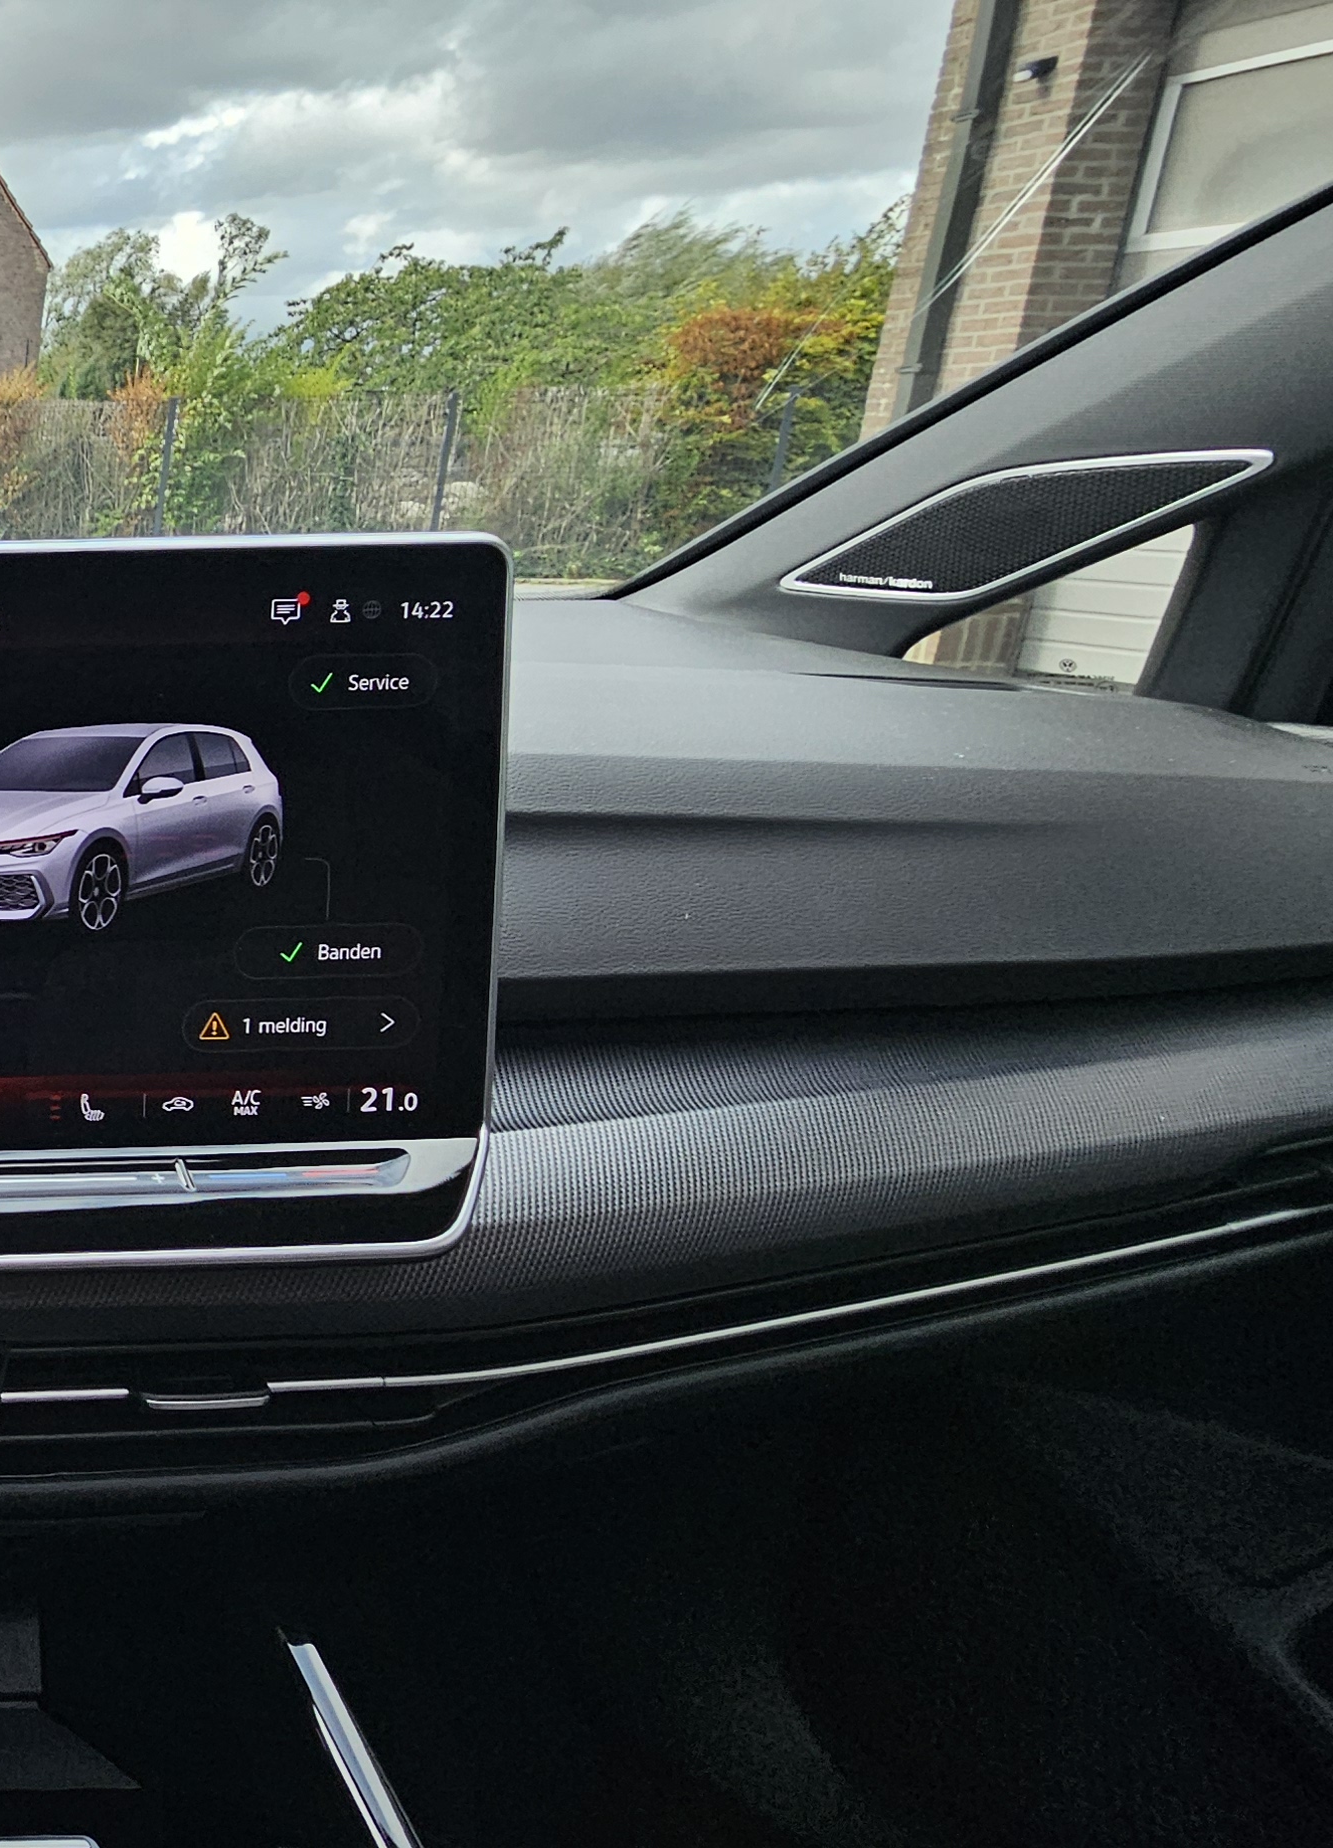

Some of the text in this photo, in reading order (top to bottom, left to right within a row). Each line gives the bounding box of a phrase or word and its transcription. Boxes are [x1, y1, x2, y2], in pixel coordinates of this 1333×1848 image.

[400, 600, 455, 620] 14:22
[347, 673, 411, 692] Service
[317, 943, 382, 961] Banden
[242, 1016, 328, 1038] 1 melding
[231, 1089, 262, 1106] A/C
[360, 1087, 419, 1113] 21.0
[233, 1106, 258, 1116] MAX
